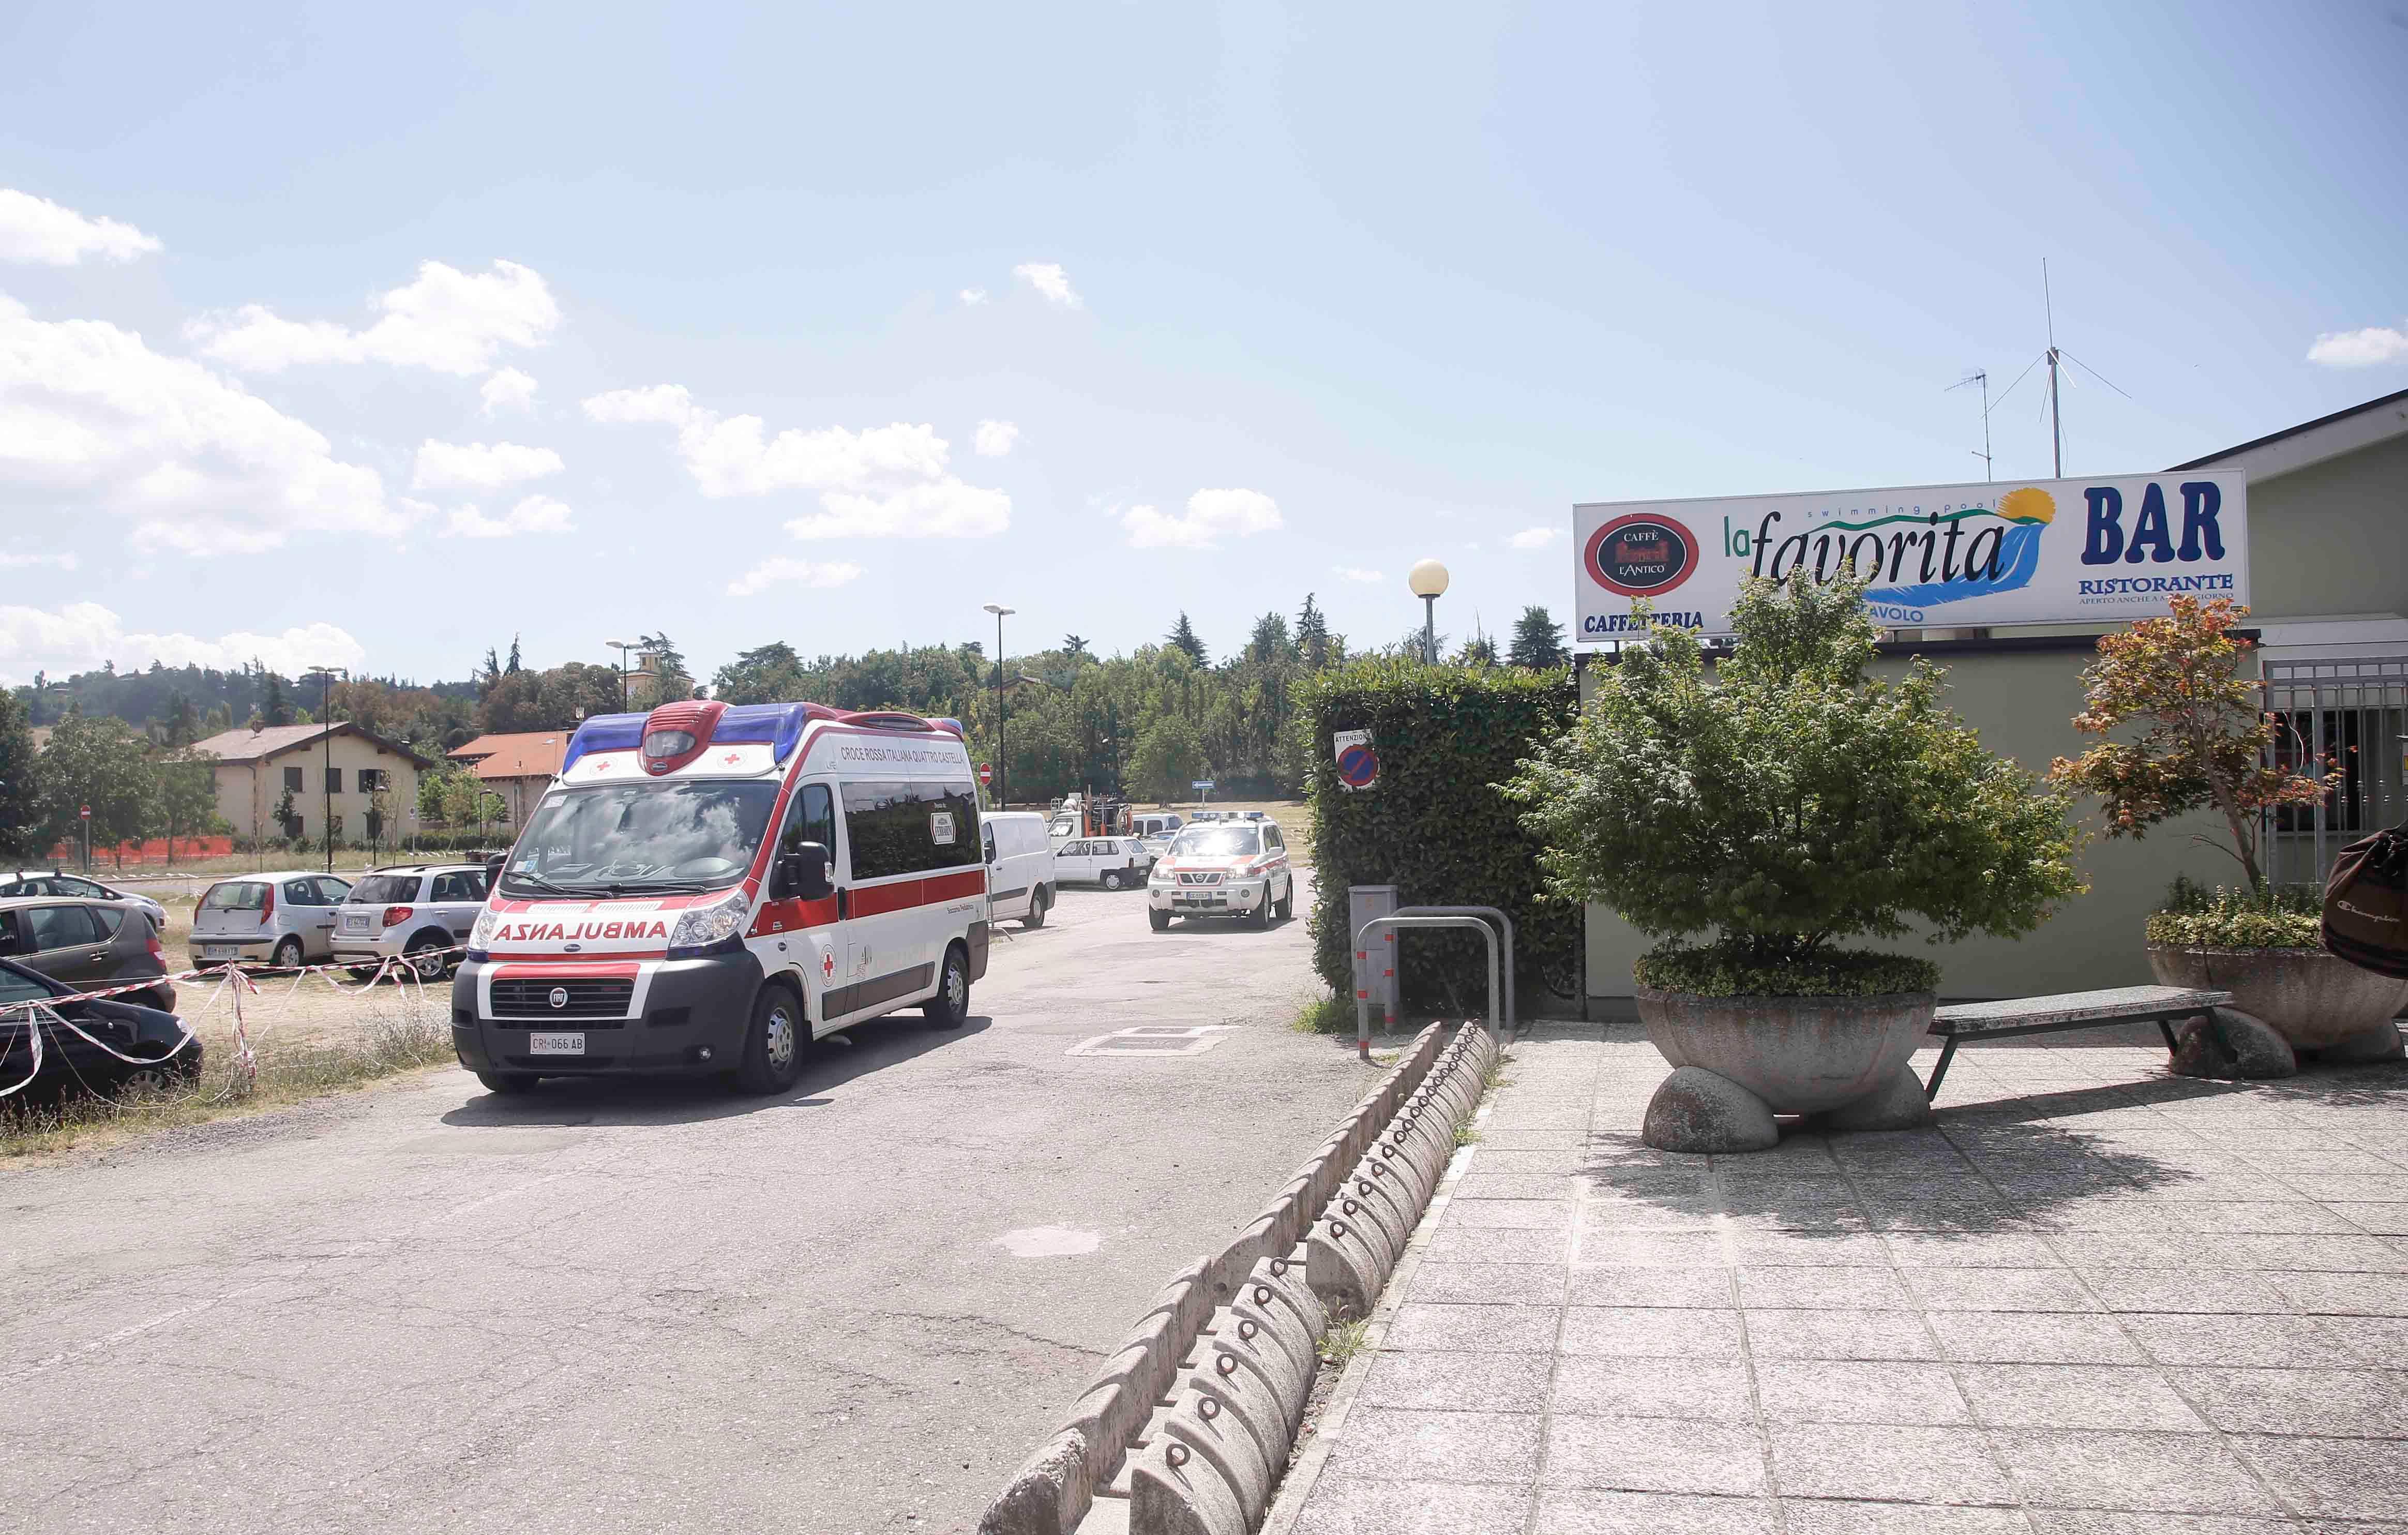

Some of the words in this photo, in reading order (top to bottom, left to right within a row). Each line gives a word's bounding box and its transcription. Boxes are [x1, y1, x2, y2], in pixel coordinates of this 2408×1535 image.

[1807, 503, 1921, 518] swimming
[1944, 499, 1996, 514] pool
[2081, 481, 2225, 565] BAR
[1623, 529, 1659, 542] CAFFÈ
[1723, 515, 1751, 558] la
[1751, 510, 2005, 588] favorita
[2078, 573, 2233, 595] RISTORANTE
[2117, 595, 2151, 604] ANCHE
[1335, 733, 1371, 743] ATTENZIONE
[840, 746, 865, 761] CROCE
[865, 747, 886, 762] ROSSA
[886, 749, 913, 762] ITALIANA
[913, 750, 938, 763] QUATTRO
[938, 751, 964, 764] CASTELLA
[553, 992, 565, 1003] FIAT
[551, 1038, 568, 1049] 066
[571, 1038, 583, 1049] AB
